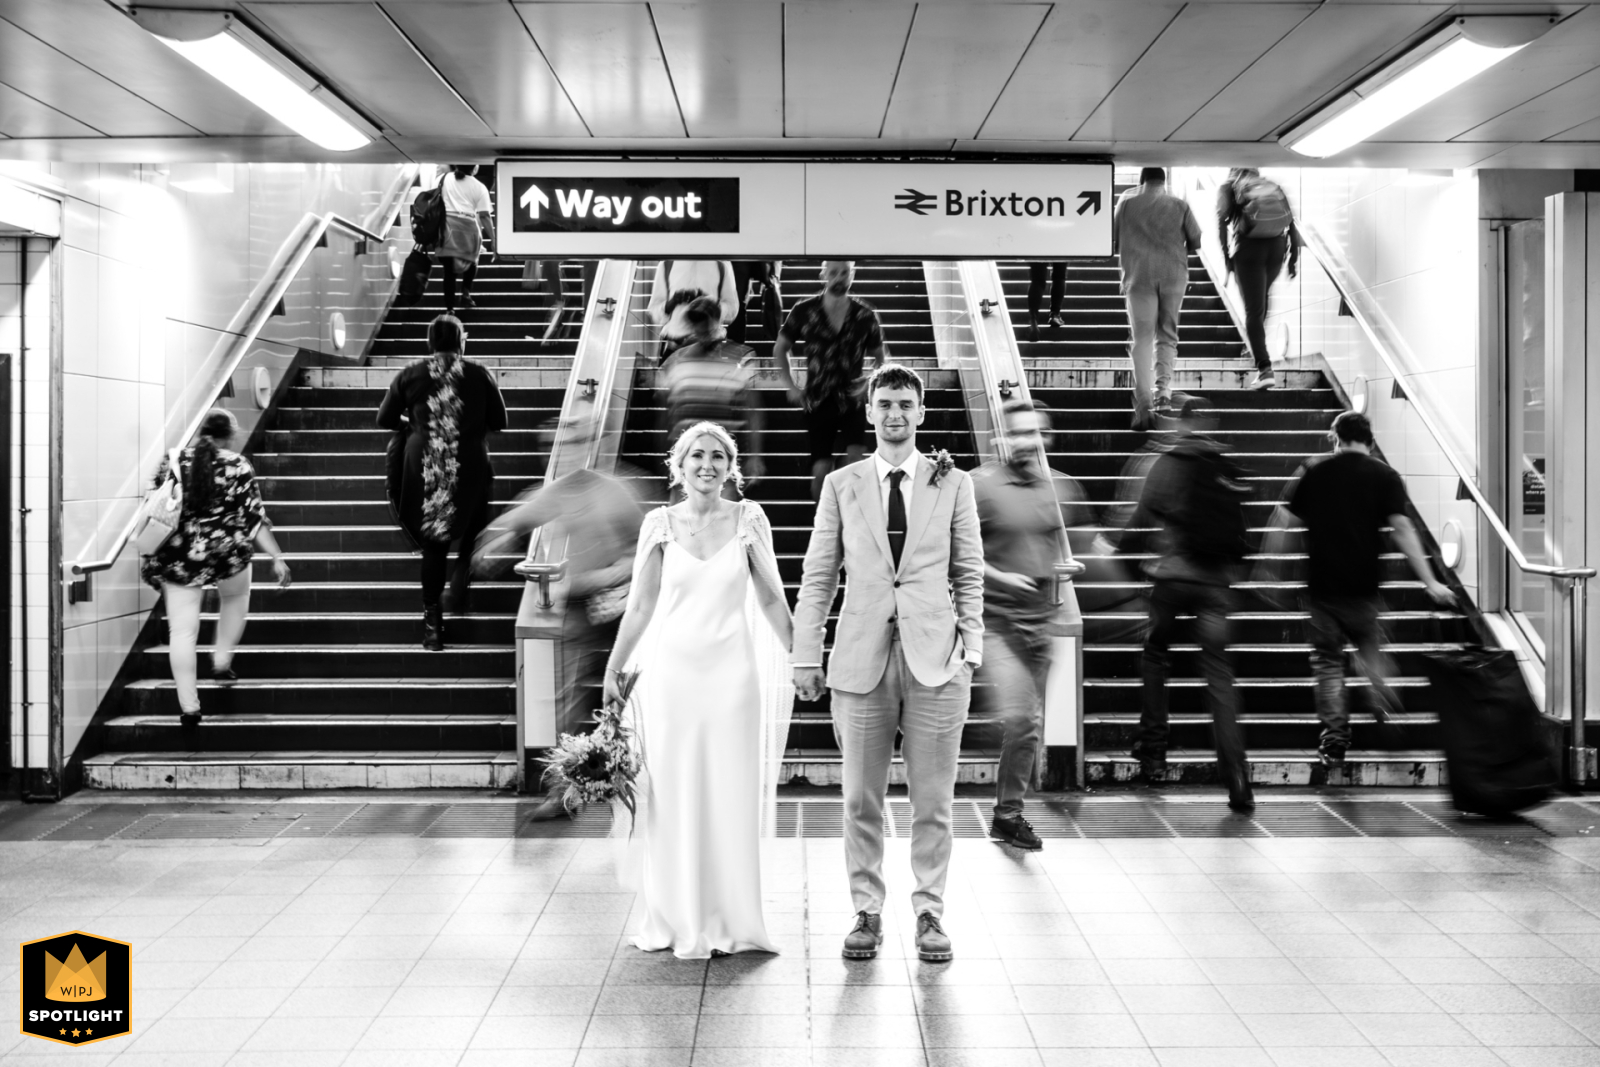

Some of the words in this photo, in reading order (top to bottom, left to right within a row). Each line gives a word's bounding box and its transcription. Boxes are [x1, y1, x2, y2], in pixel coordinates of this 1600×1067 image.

[555, 188, 632, 224] Way
[641, 191, 702, 219] out
[945, 189, 1065, 217] Brixton
